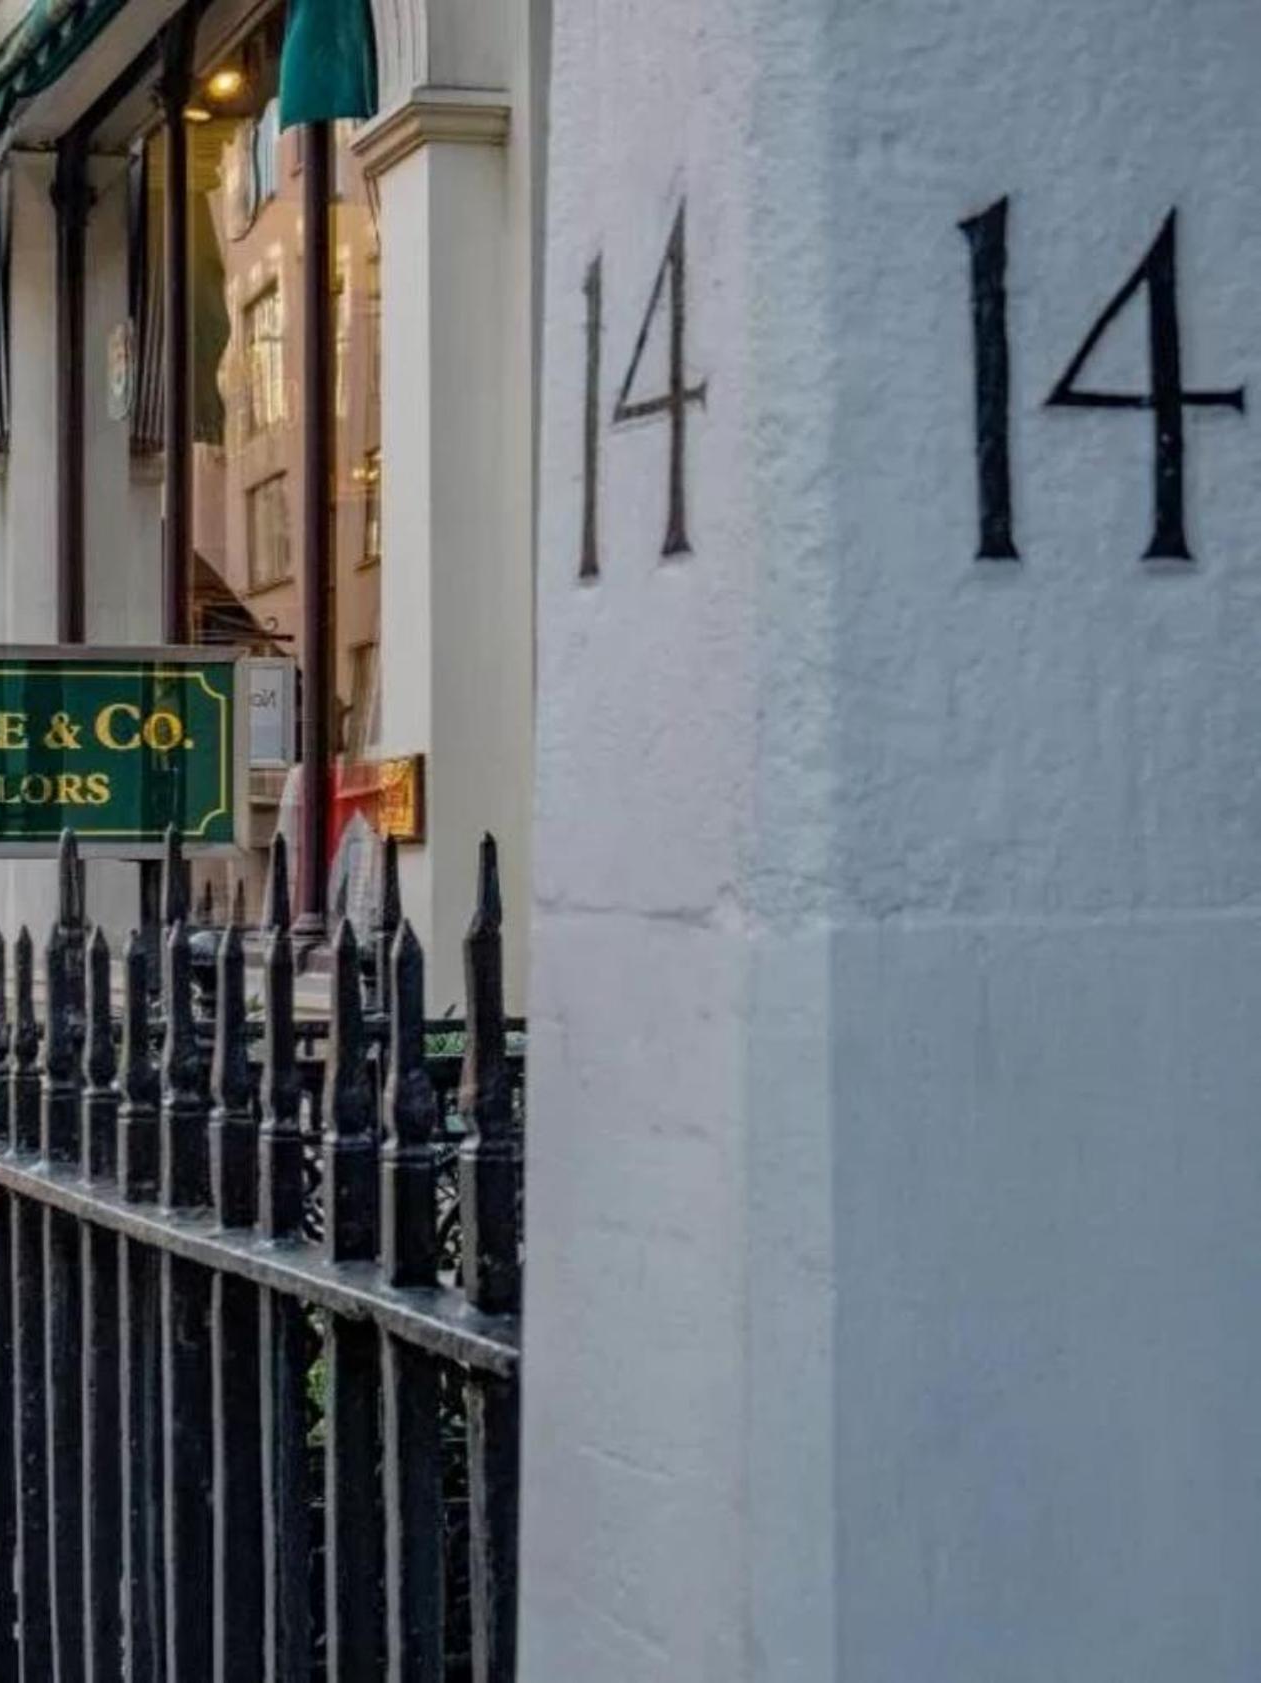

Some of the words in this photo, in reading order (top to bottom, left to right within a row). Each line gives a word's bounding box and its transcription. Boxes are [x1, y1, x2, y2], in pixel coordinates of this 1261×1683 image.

[581, 194, 708, 578] 14
[956, 195, 1245, 561] 14
[44, 711, 81, 750] &
